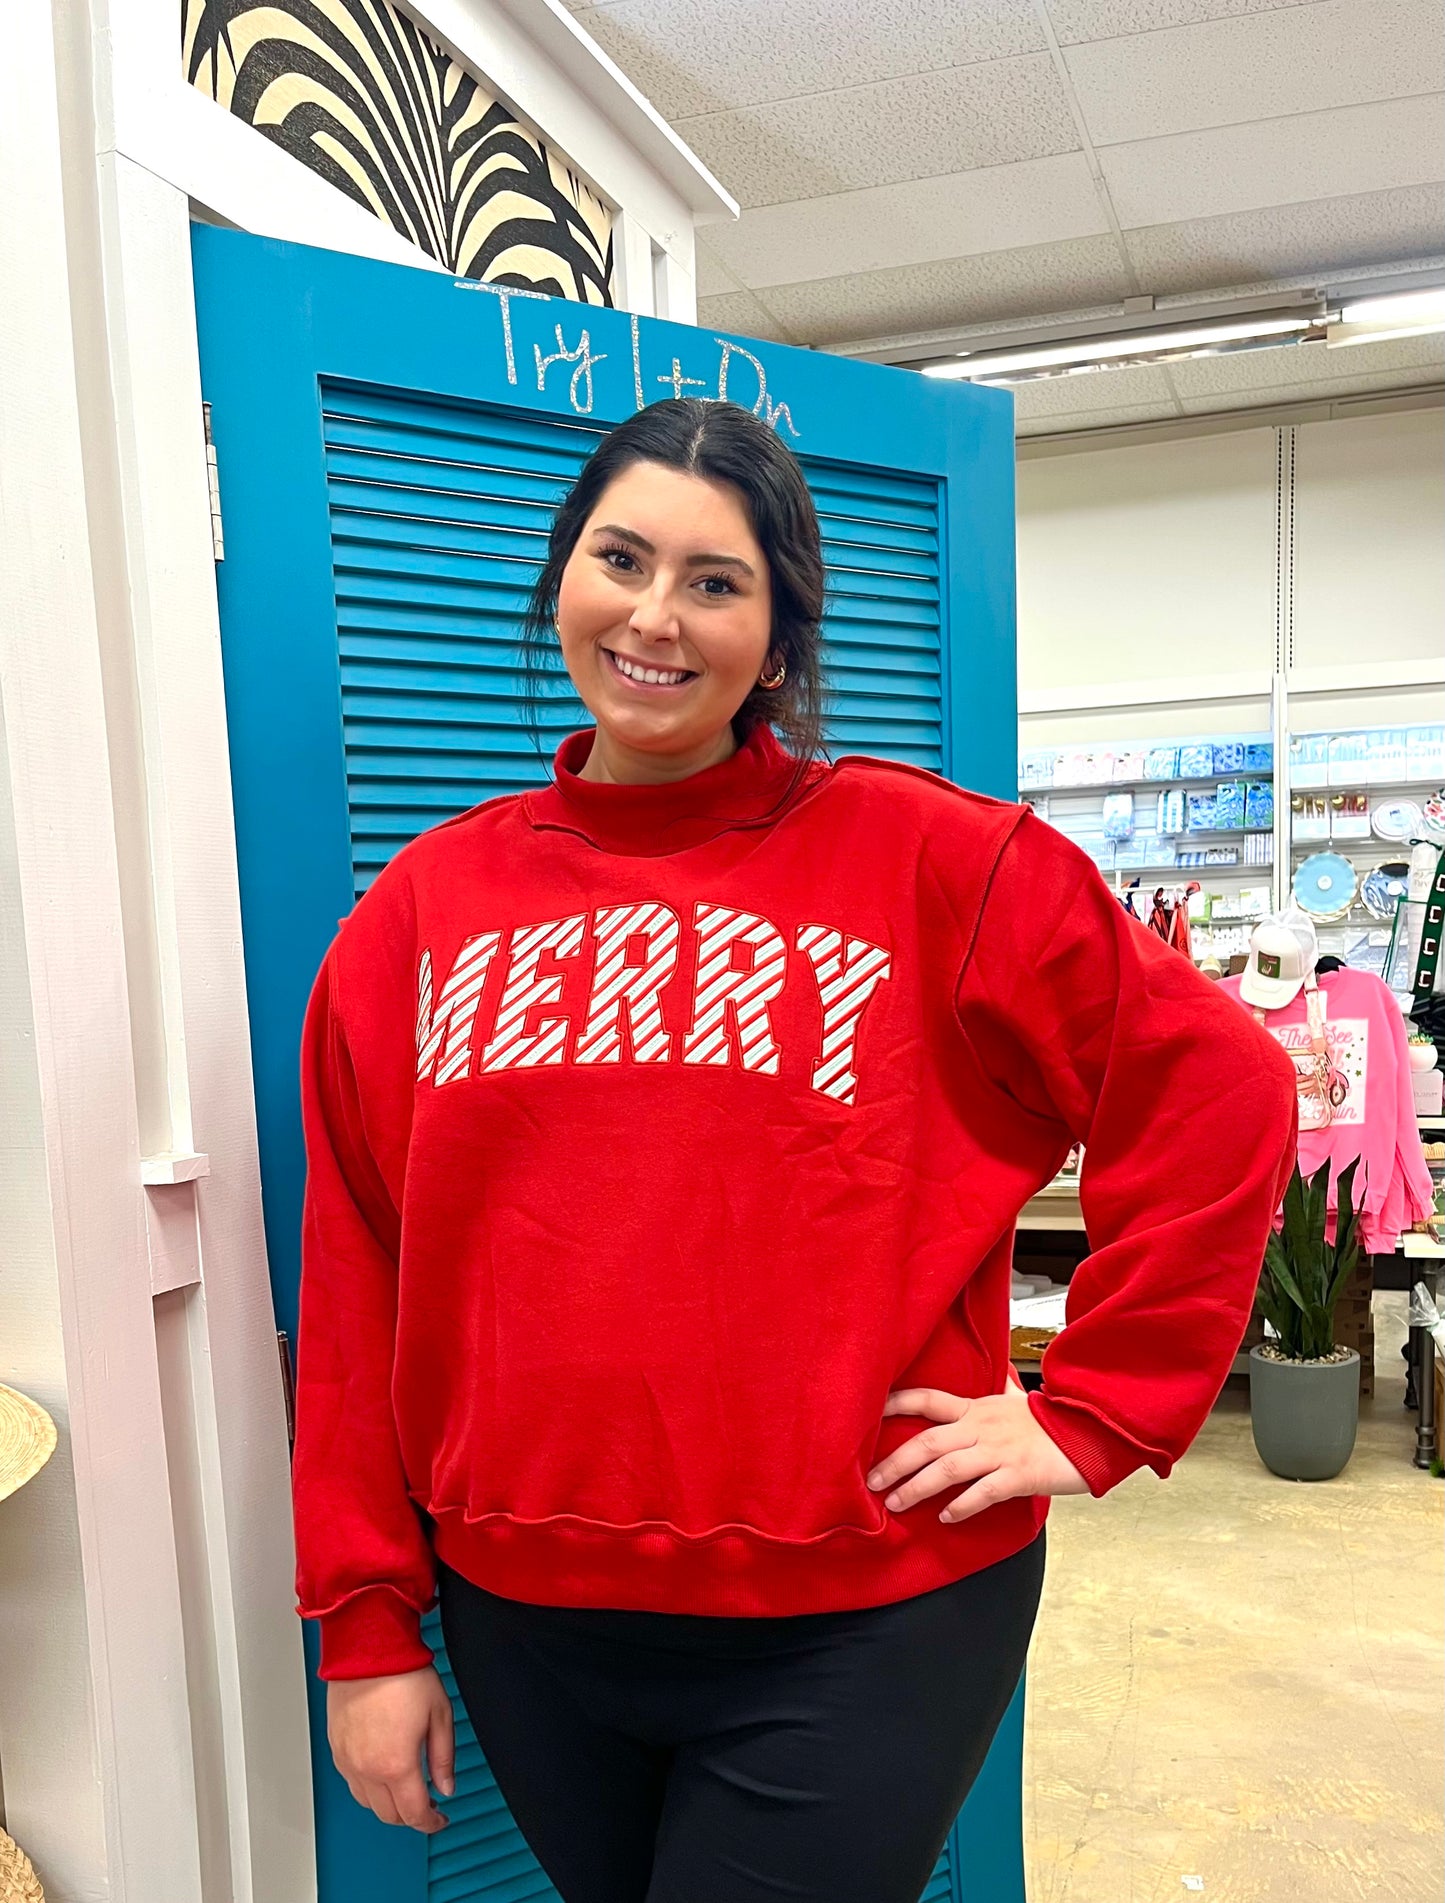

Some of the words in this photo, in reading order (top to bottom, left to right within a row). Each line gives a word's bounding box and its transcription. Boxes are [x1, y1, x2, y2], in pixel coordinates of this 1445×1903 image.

[453, 280, 608, 415] Try
[630, 314, 707, 412] It
[415, 900, 893, 1107] MERRY
[1324, 1025, 1354, 1046] See
